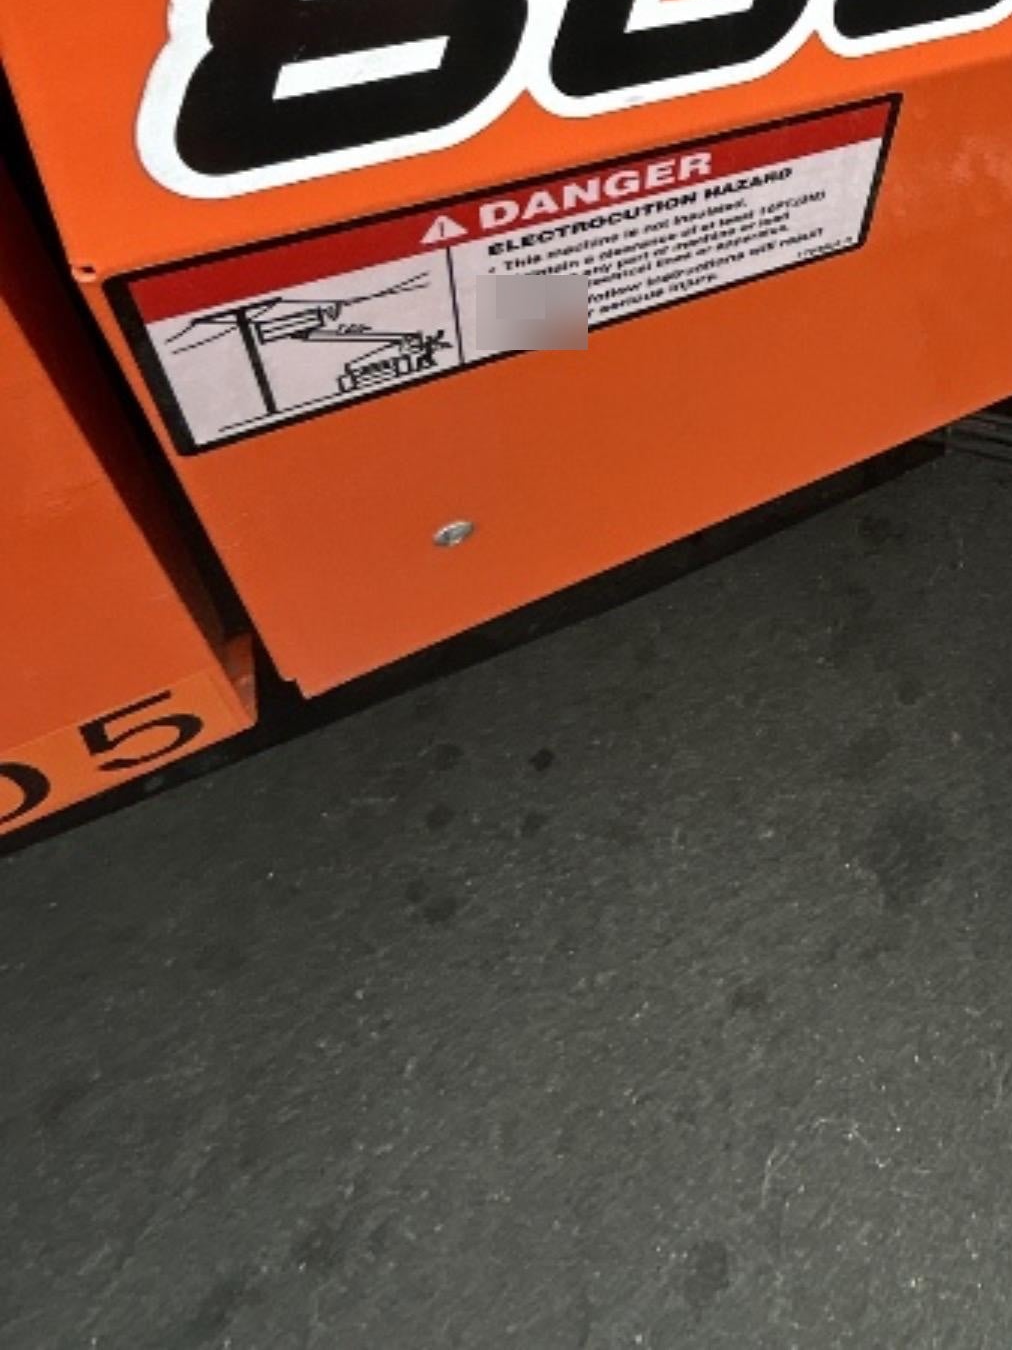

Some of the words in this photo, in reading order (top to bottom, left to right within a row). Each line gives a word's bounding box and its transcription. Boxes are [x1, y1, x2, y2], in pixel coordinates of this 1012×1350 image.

[480, 152, 712, 229] DANGER
[488, 190, 696, 256] ELECTROCUTION
[704, 165, 793, 200] HAZARD
